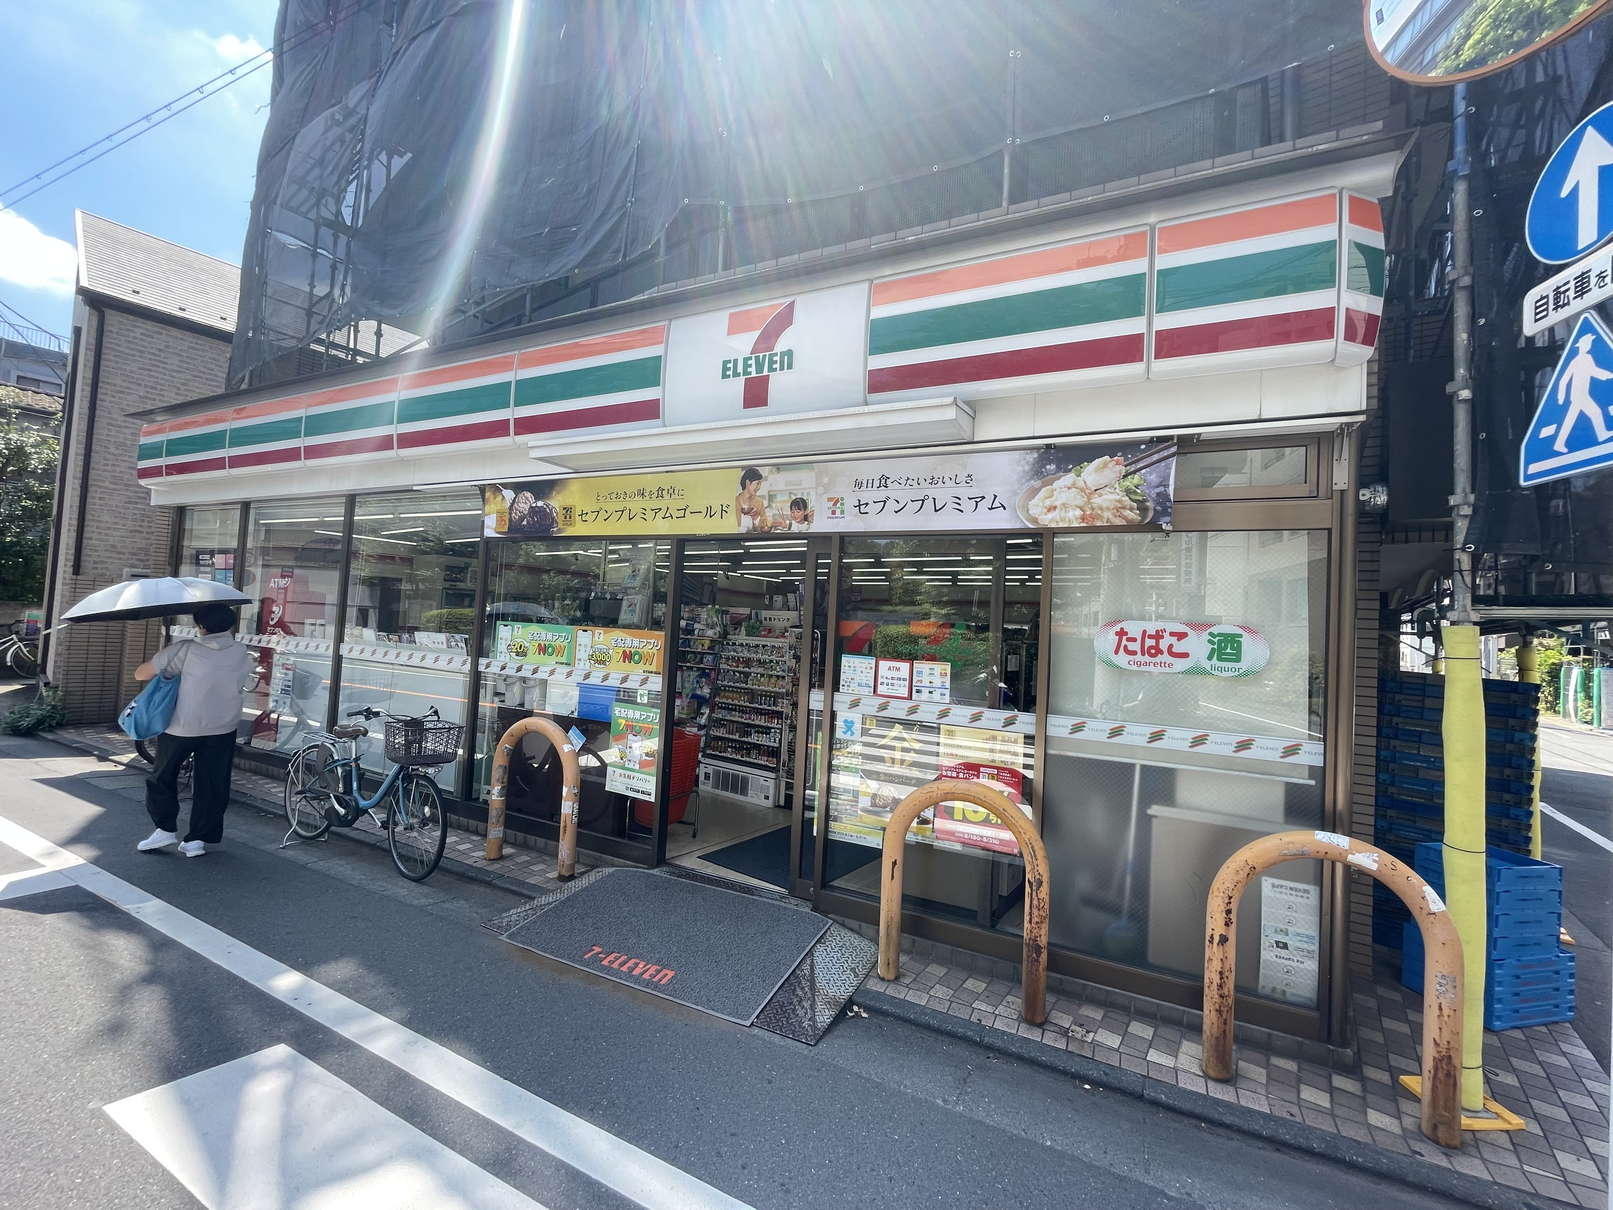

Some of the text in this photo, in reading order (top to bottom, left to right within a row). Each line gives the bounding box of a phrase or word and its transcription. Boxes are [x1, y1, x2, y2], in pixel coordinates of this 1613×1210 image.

[1534, 255, 1613, 323] 自転車を
[853, 474, 974, 490] 毎日食べたいおいしさ
[595, 486, 685, 501] とっておきの味を食卓に
[577, 503, 730, 524] セブンプレミアムゴールド
[853, 493, 1007, 516] セブンプレミアム
[1114, 627, 1243, 664] たばこ 酒
[1127, 658, 1243, 675] cigarette liquor
